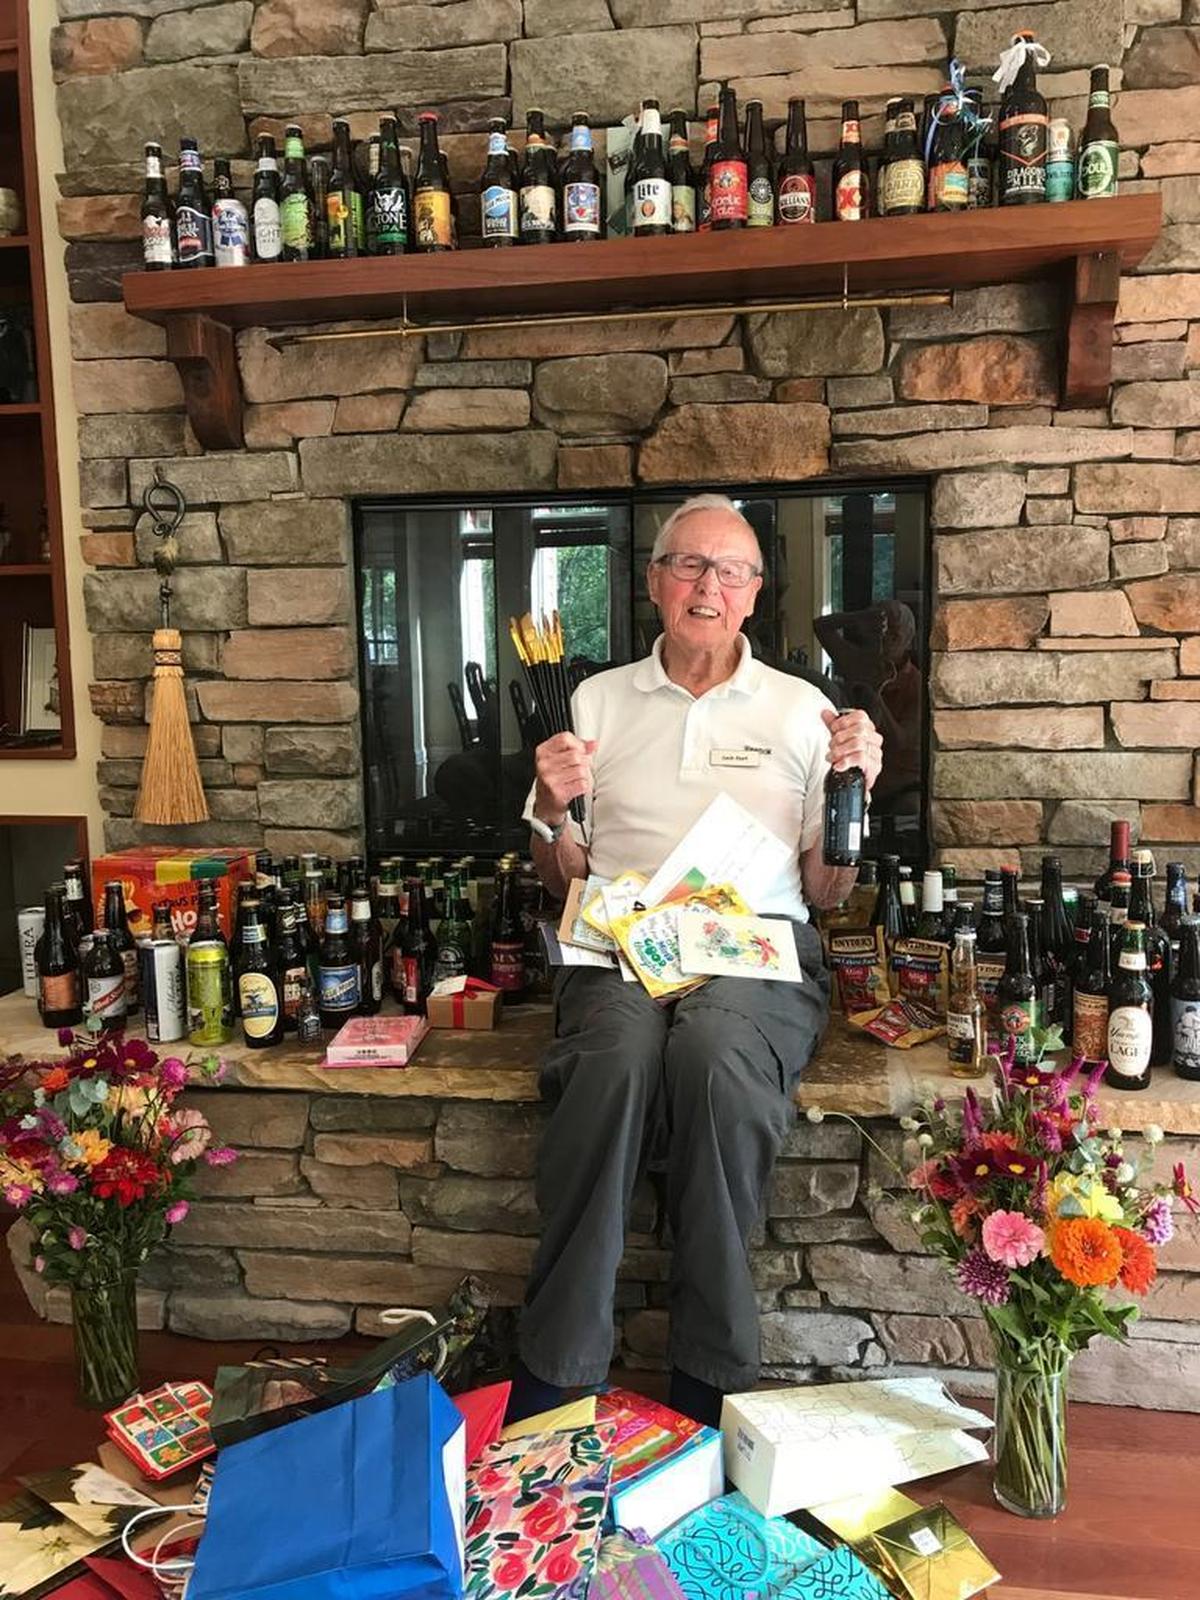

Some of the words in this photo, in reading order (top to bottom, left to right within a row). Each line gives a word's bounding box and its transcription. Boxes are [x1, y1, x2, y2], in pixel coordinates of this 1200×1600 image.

[258, 229, 281, 238] IGHT
[171, 909, 198, 933] HO
[23, 927, 35, 979] ULTRA
[1110, 1045, 1139, 1057] LAGE
